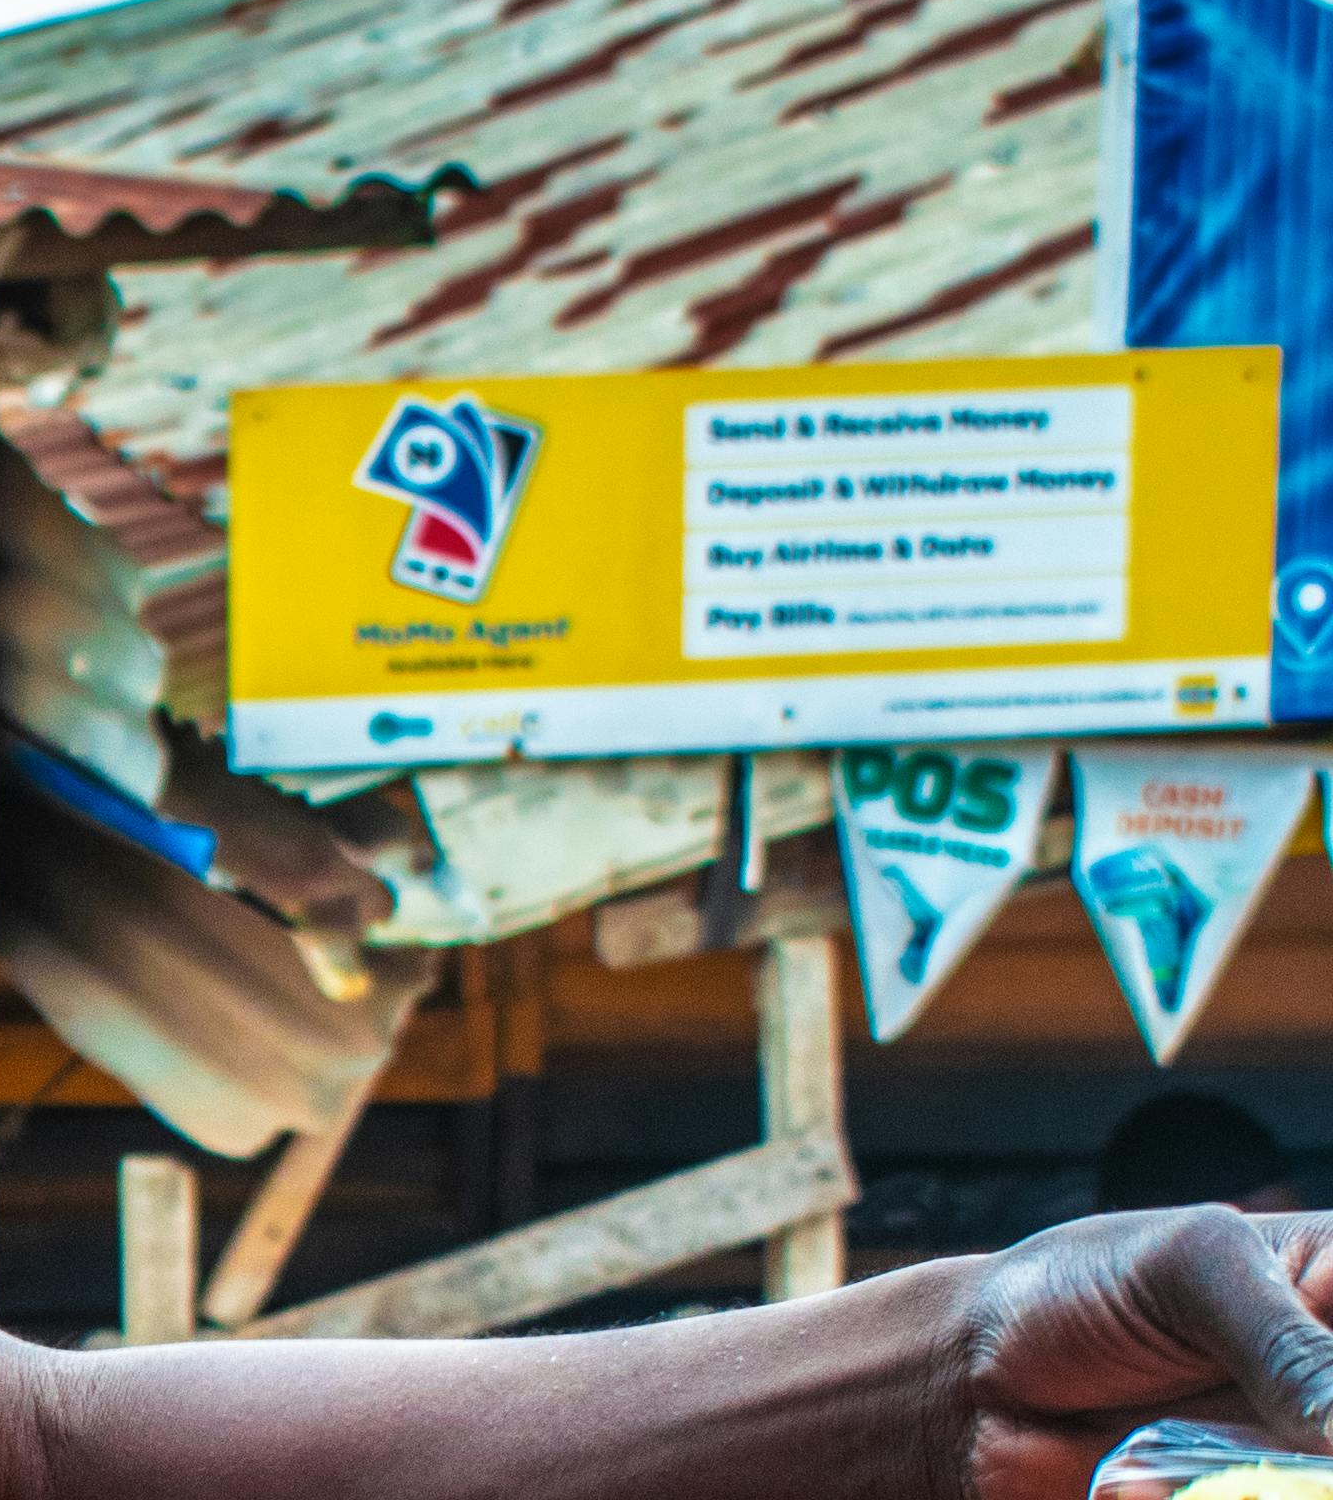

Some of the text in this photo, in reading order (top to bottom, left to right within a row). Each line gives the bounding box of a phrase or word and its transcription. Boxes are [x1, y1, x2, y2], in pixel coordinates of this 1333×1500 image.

[710, 407, 1050, 443] Send & Receive Money
[709, 466, 1115, 506] Deposit & Withdraw Money
[708, 534, 994, 569] Buy Airtime & Data
[352, 616, 571, 650] MoMo Agent
[707, 605, 762, 634] Pay
[771, 601, 835, 628] Bills
[842, 747, 1021, 834] POS
[1140, 782, 1226, 809] CASH
[1115, 811, 1245, 841] DEPOSIT
